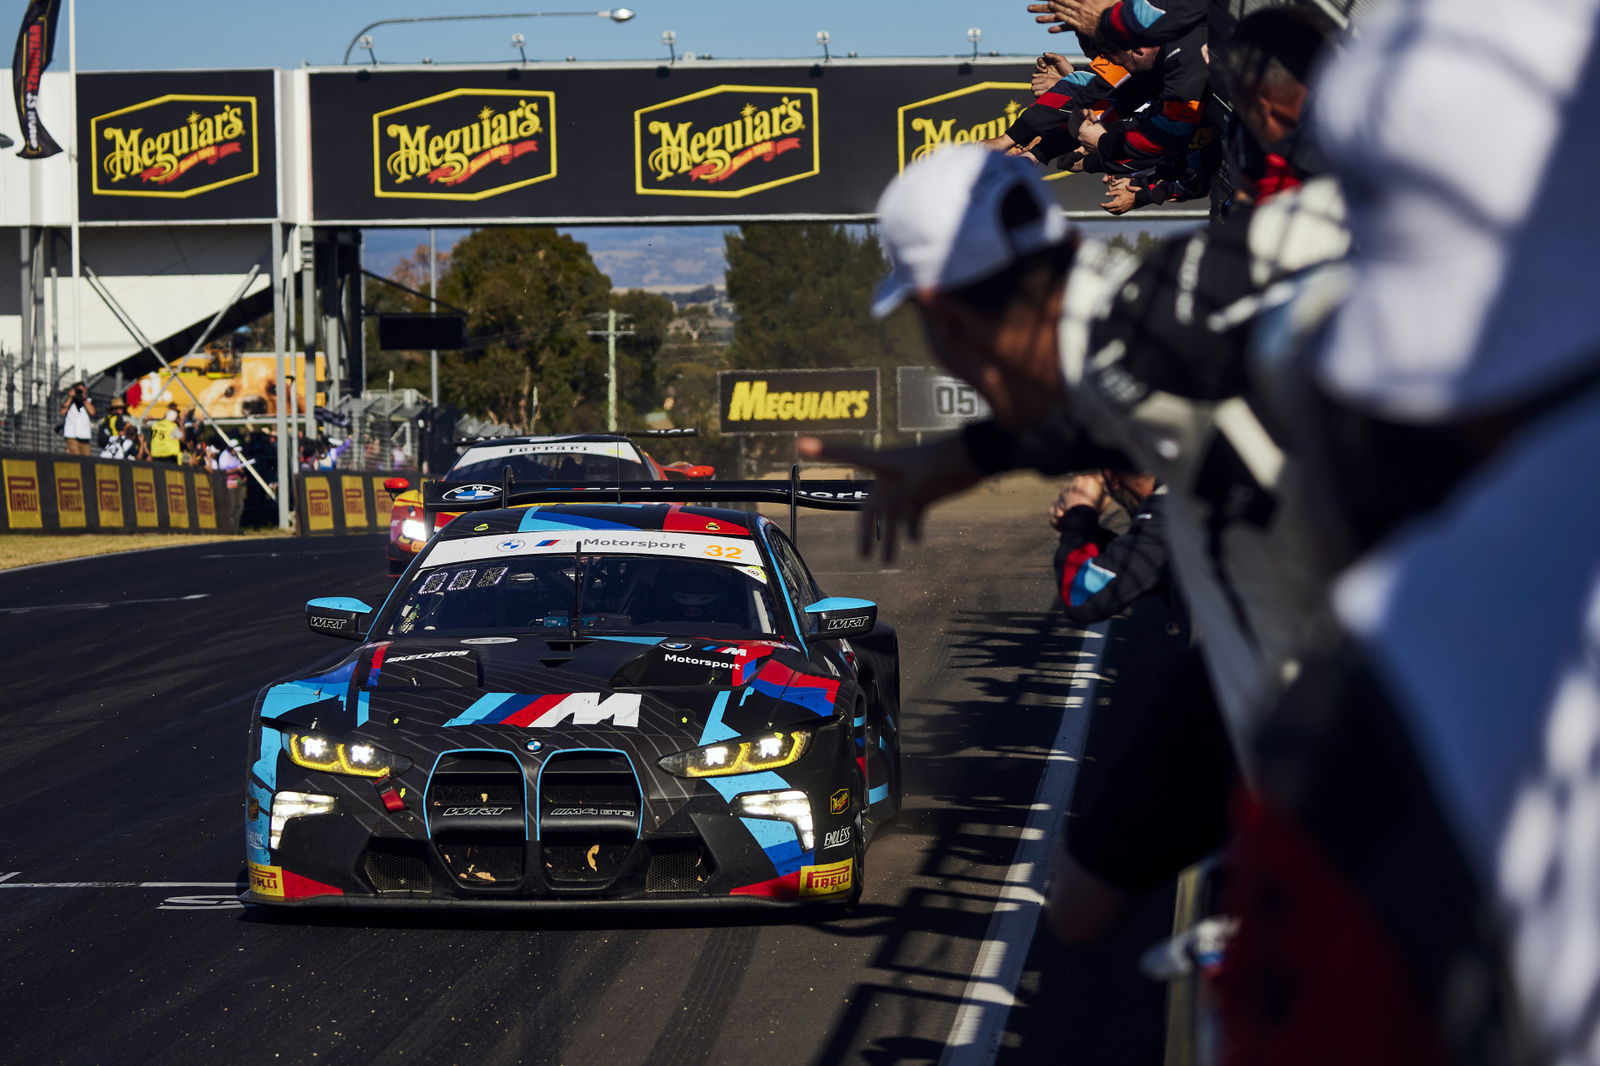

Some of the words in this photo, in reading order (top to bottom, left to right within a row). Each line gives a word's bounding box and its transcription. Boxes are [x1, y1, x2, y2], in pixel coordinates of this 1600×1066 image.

[103, 104, 245, 183] Meguiar's
[386, 100, 542, 184] Meguiar's
[648, 97, 805, 182] Meguiar's
[583, 538, 687, 550] Motorsport
[705, 545, 743, 559] 32
[310, 616, 348, 630] WRT
[827, 615, 870, 630] WRT
[664, 653, 741, 670] Motorsport
[442, 807, 513, 817] WRT
[823, 826, 851, 848] ENDLESS
[806, 865, 850, 889] PIRELLI
